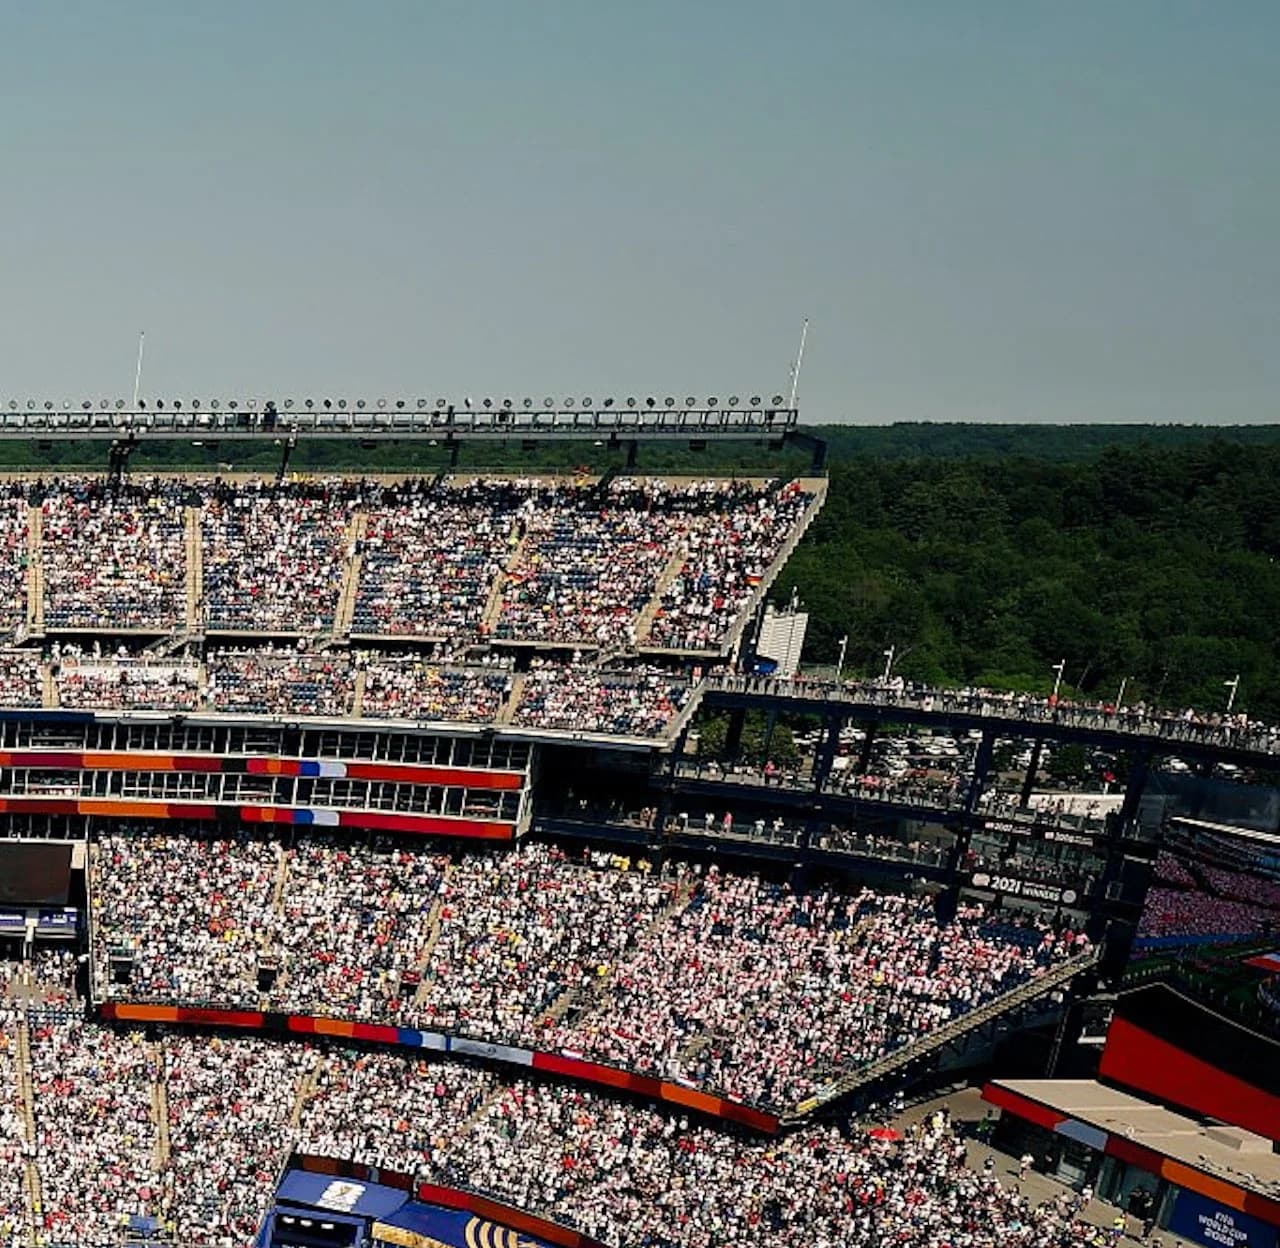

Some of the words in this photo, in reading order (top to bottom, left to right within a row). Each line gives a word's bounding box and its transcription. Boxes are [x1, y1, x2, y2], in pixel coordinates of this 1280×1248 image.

[991, 875, 1022, 894] 2021
[295, 1140, 353, 1161] NEUSS
[353, 1148, 417, 1176] KETSCH
